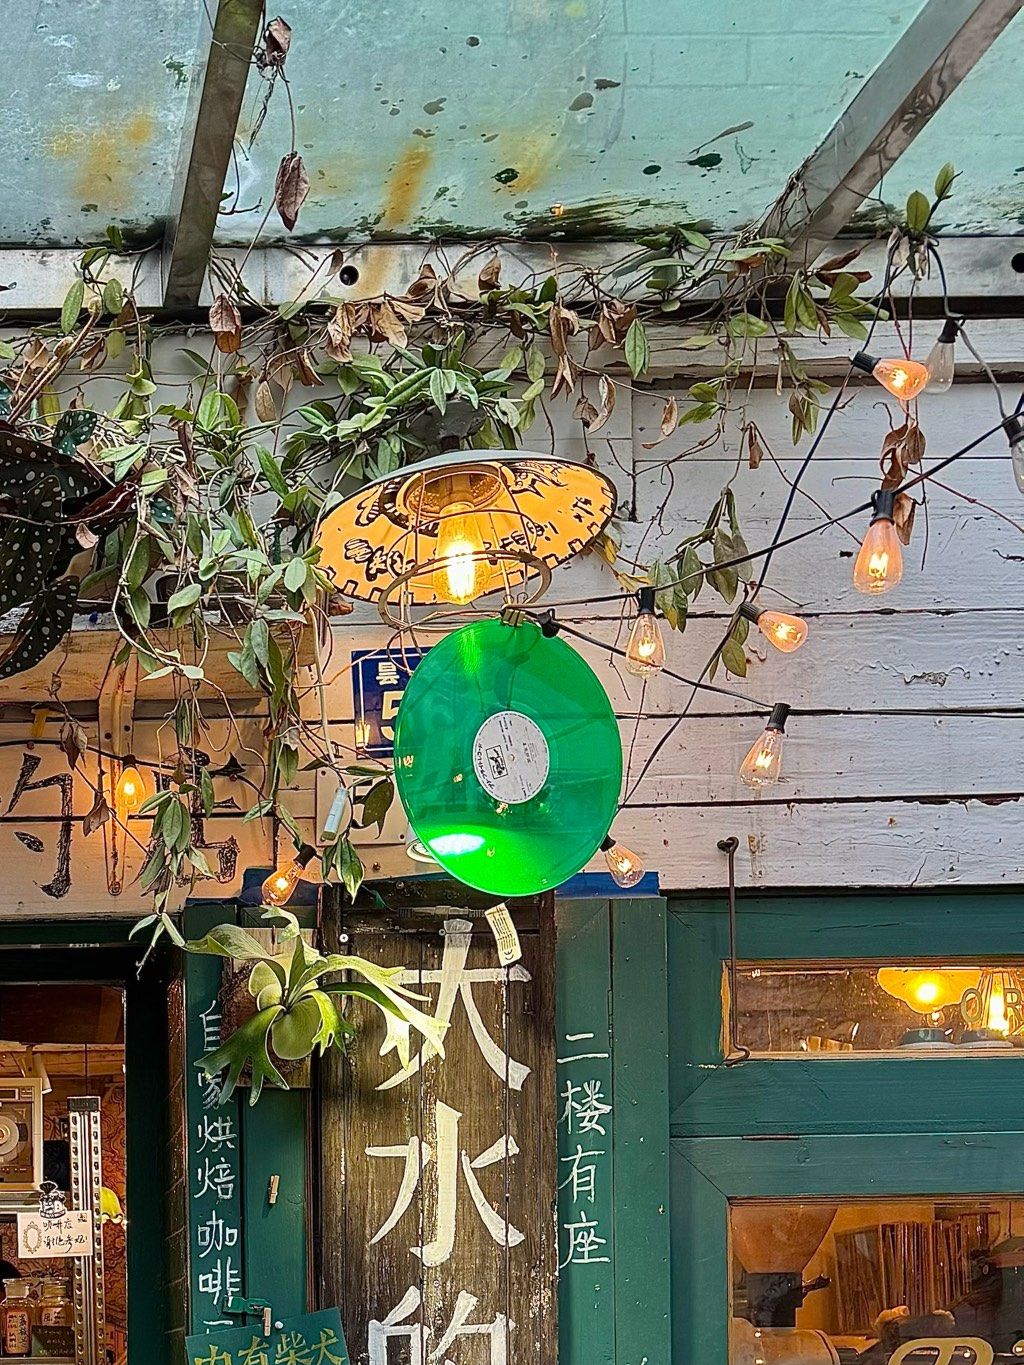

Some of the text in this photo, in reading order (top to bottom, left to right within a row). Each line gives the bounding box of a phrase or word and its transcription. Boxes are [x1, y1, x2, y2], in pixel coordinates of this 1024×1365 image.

[194, 1000, 240, 1334] 自家烘焙咖啡
[556, 1032, 615, 1272] 二楼有座
